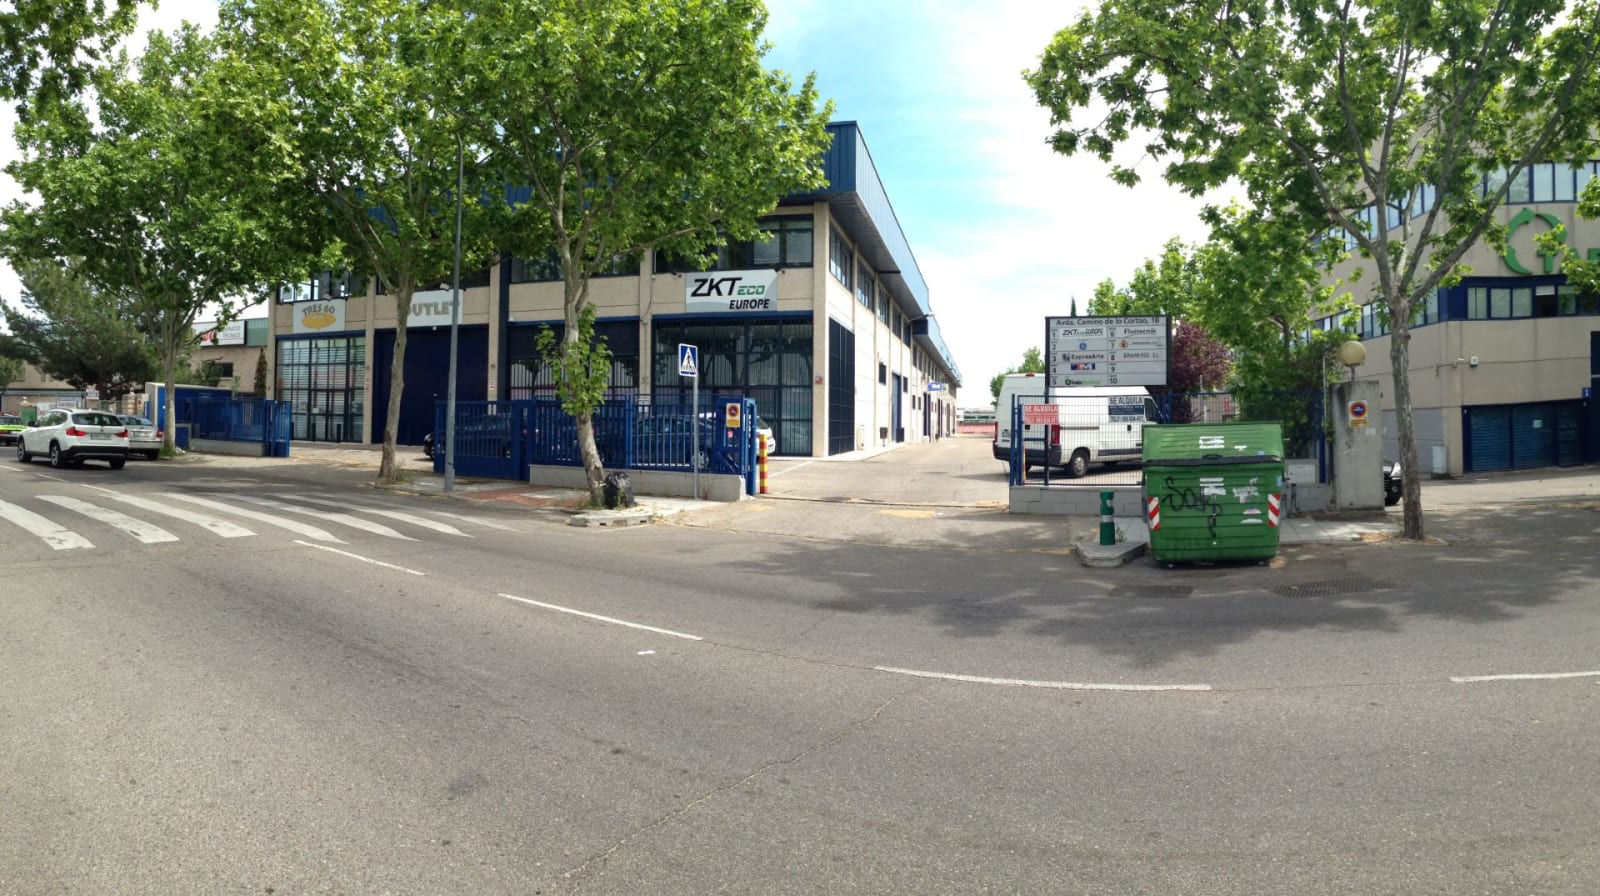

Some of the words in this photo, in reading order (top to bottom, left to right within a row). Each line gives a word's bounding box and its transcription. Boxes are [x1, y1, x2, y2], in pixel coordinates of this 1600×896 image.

[302, 304, 322, 316] TRES
[729, 298, 770, 310] EUROPE
[1109, 396, 1117, 404] SE
[1119, 396, 1143, 404] ALQUILA
